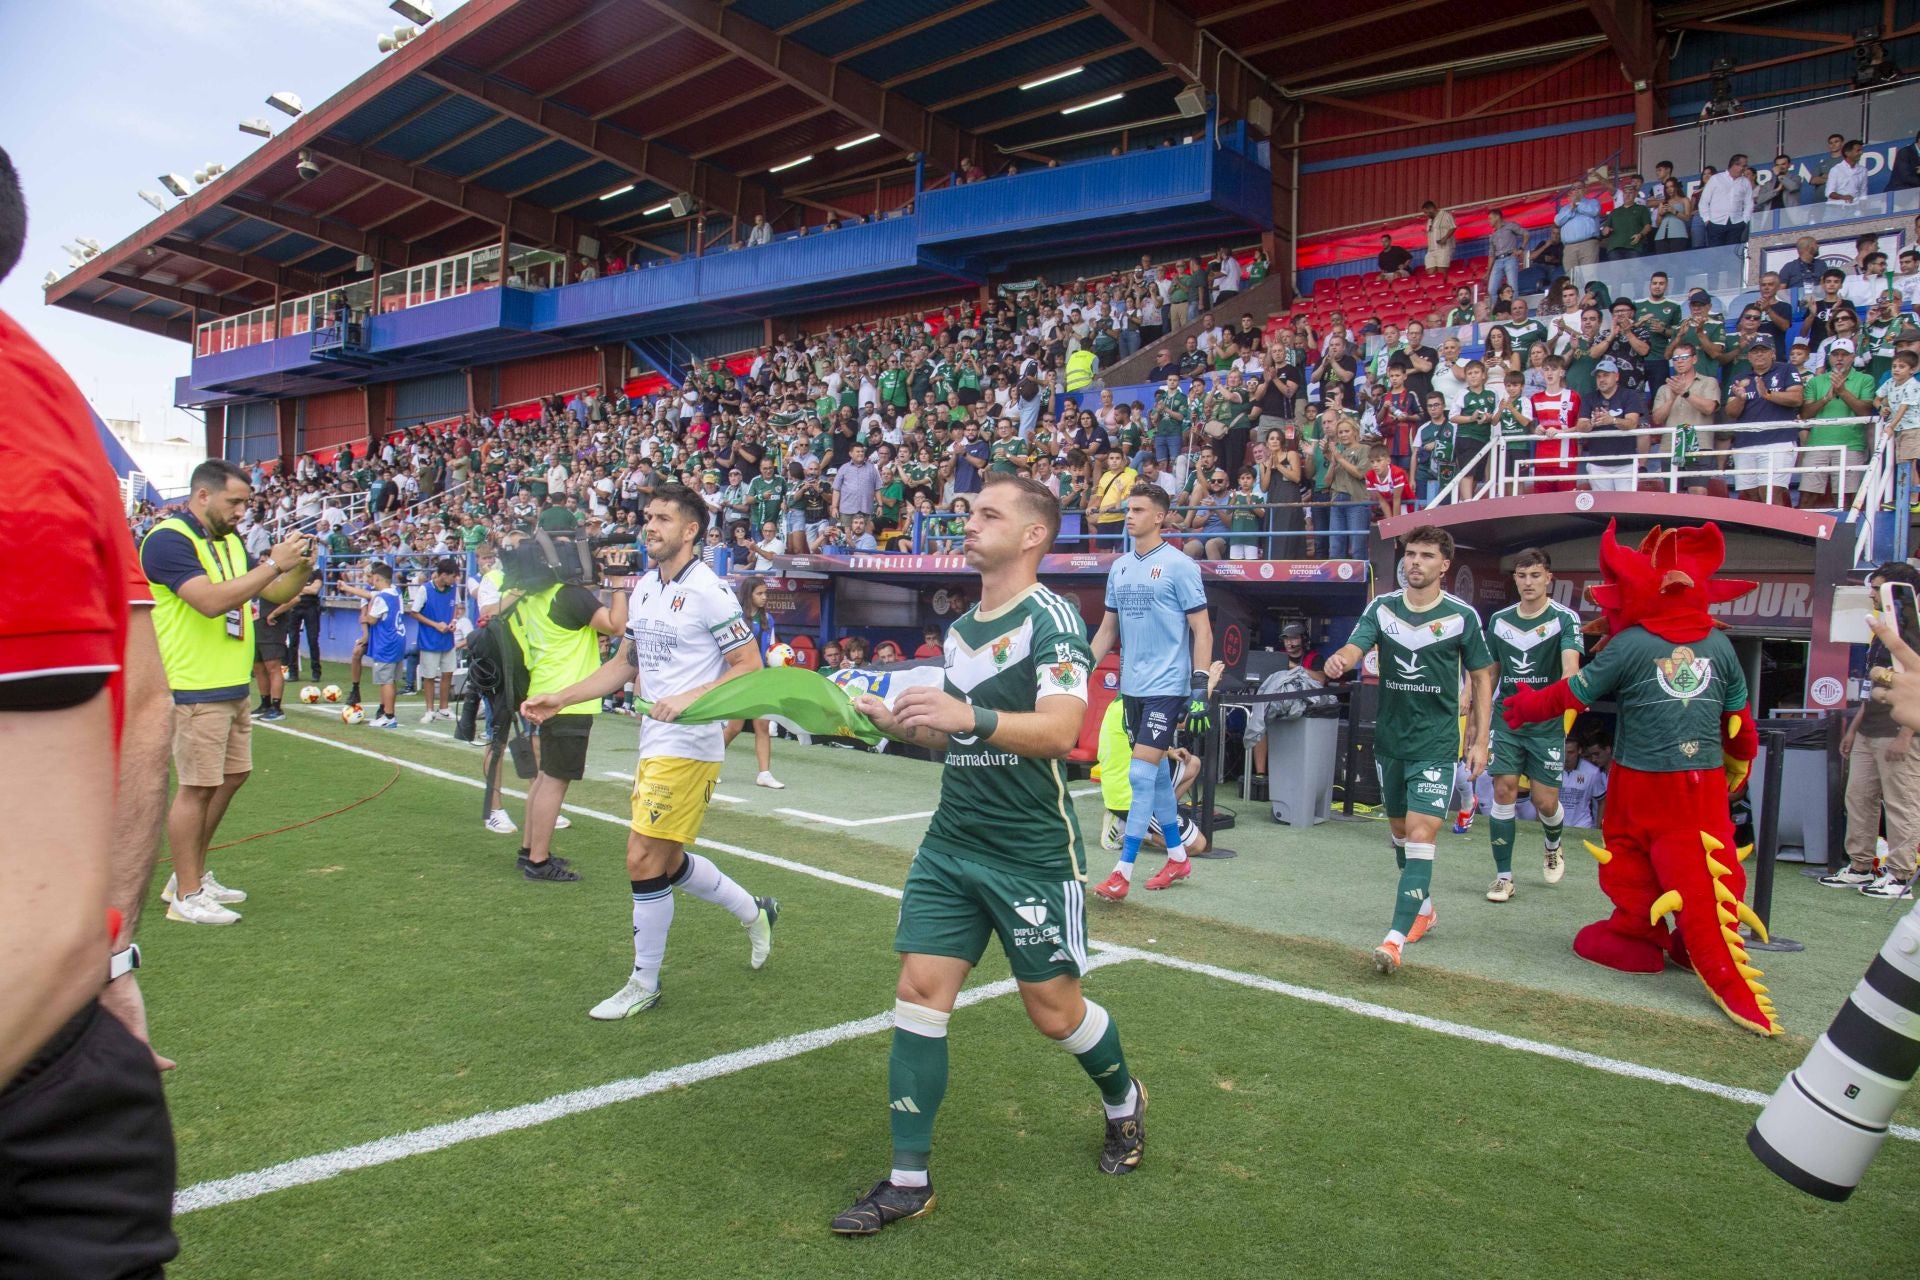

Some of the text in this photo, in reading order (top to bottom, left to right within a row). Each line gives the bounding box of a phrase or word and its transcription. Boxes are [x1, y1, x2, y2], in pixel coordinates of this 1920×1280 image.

[849, 557, 967, 570] BANQUILLO VISI
[766, 601, 796, 610] CTORIA
[1503, 675, 1549, 684] Exremadura
[1385, 680, 1441, 694] Extremadura
[944, 750, 1019, 767] tremadura
[1015, 937, 1027, 946] DE
